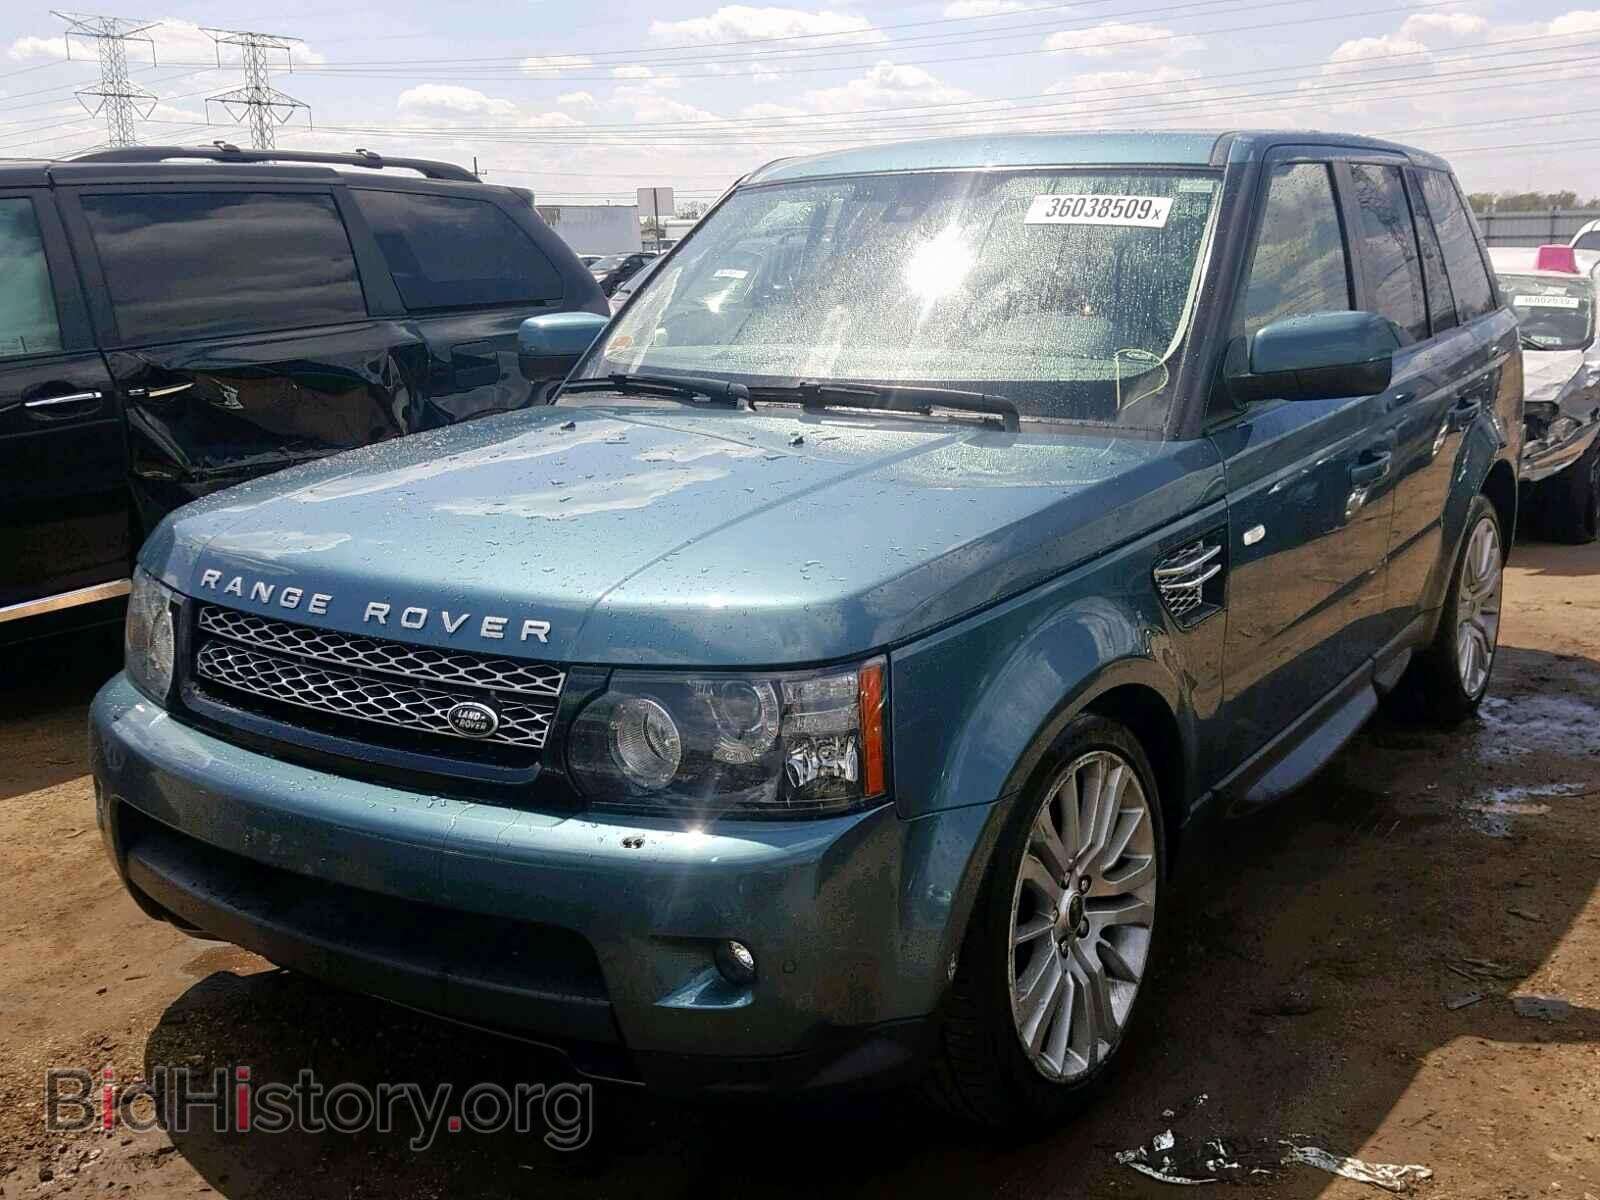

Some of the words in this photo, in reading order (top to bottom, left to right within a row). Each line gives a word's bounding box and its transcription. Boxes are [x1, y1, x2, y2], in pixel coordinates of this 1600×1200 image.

[200, 568, 334, 616] RANGE
[363, 600, 552, 643] ROVER
[458, 709, 481, 721] LAND
[458, 718, 487, 730] ROVER
